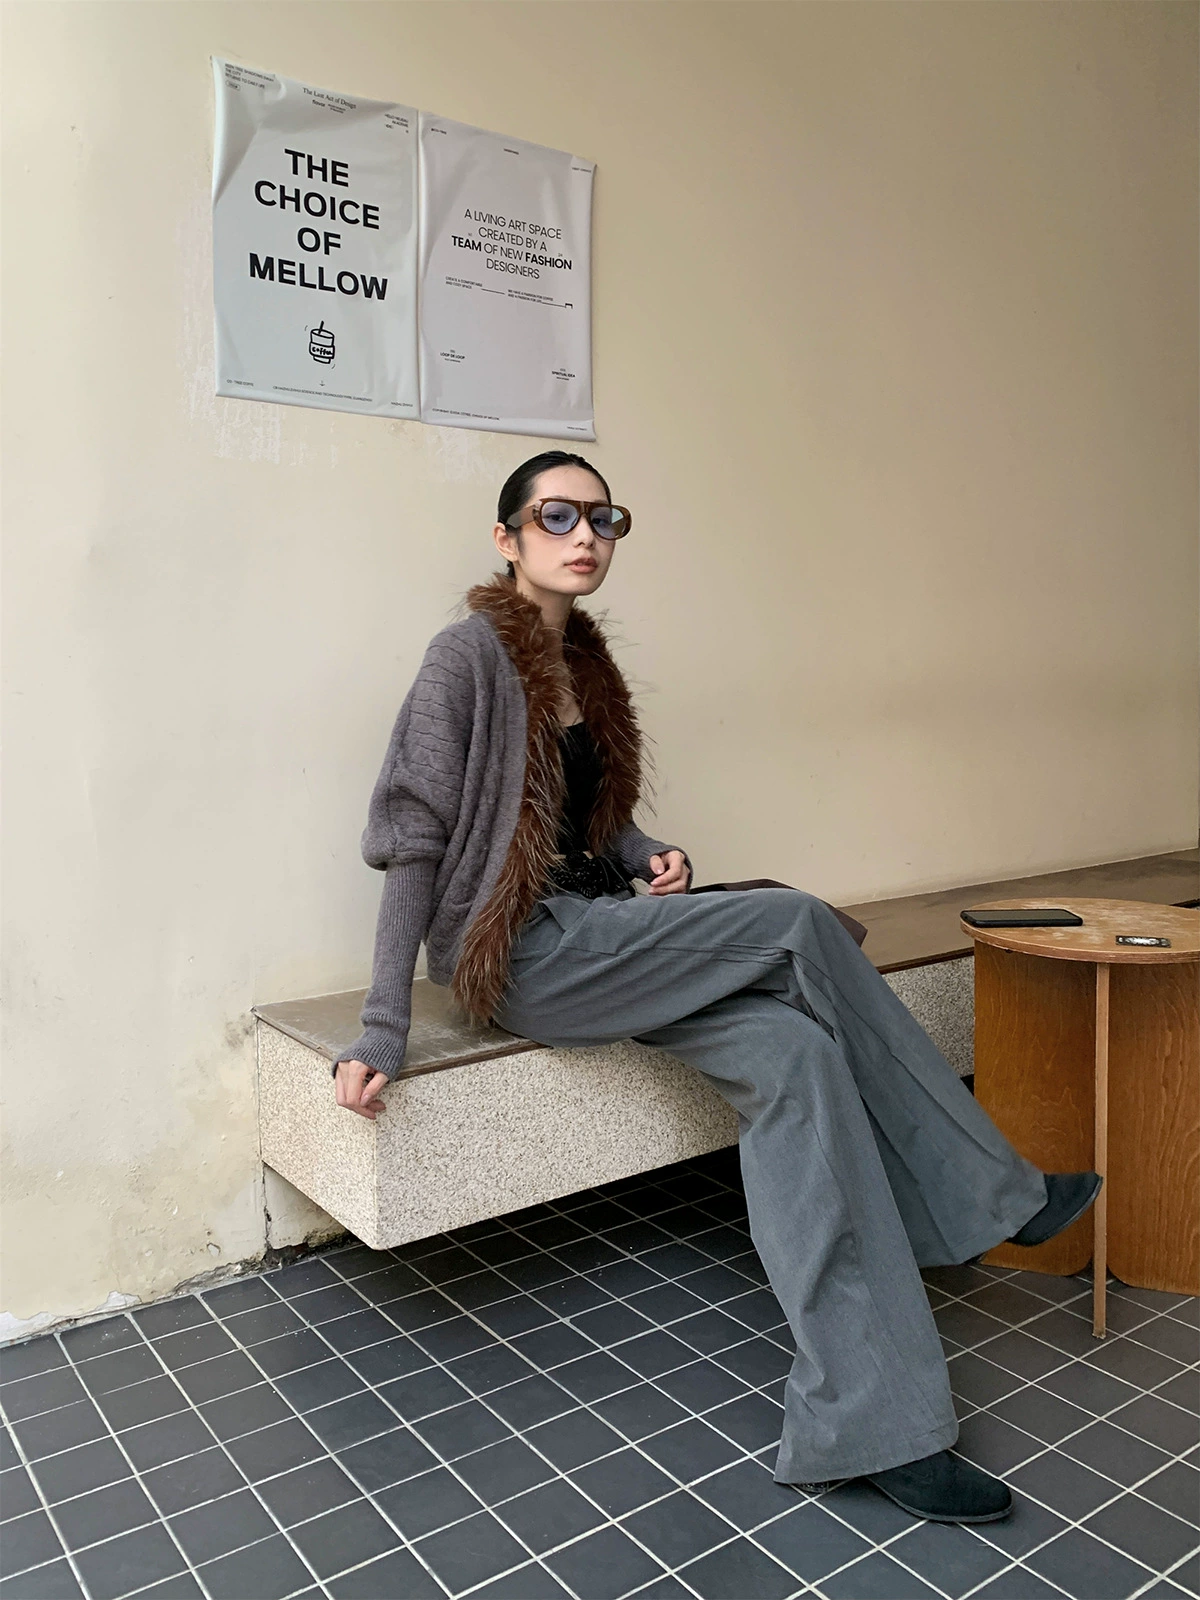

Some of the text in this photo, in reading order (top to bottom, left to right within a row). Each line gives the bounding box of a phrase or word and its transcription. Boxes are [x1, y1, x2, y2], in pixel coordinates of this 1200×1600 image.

[284, 148, 349, 188] THE
[254, 180, 380, 230] CHOICE
[464, 208, 562, 240] A LIVING ART SPACE
[478, 226, 548, 252] CREATED BY A
[297, 227, 341, 256] OF
[451, 235, 572, 270] TEAM OF NEW FASHION
[250, 252, 388, 300] MELLOW
[486, 258, 540, 280] DESIGNERS
